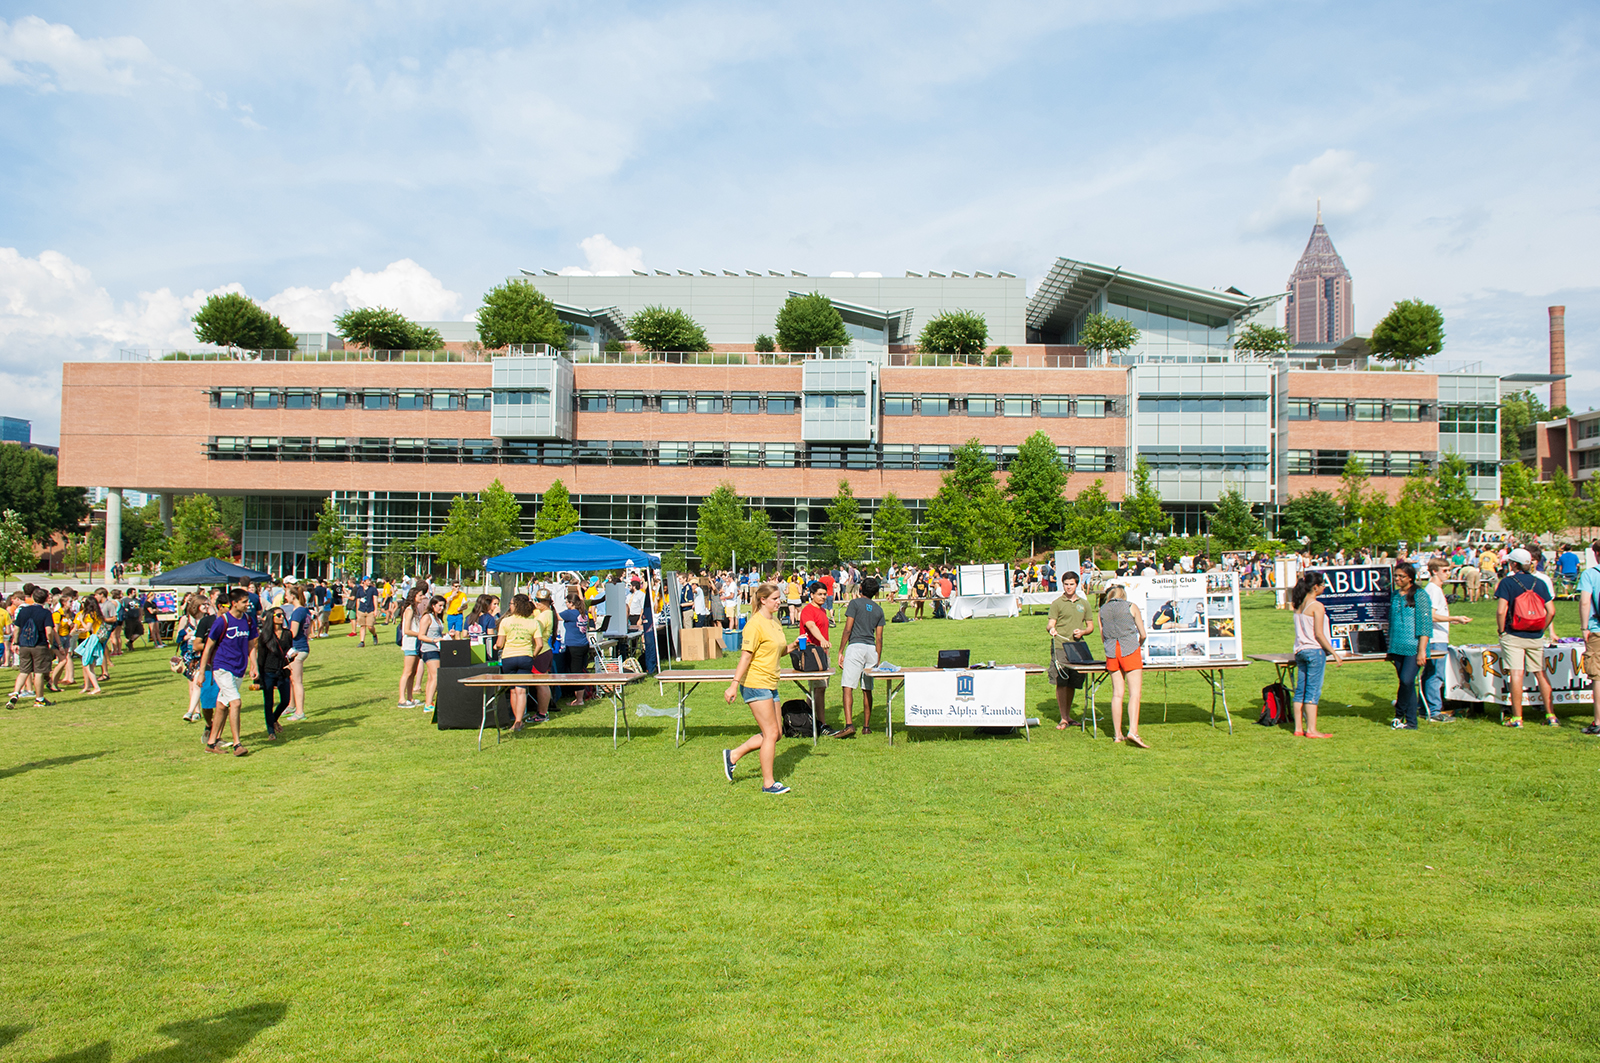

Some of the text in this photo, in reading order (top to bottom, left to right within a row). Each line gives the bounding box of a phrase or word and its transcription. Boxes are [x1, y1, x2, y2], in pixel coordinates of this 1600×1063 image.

[1323, 570, 1381, 593] ABUR
[909, 704, 1022, 718] Sigma Alpha Lambda
